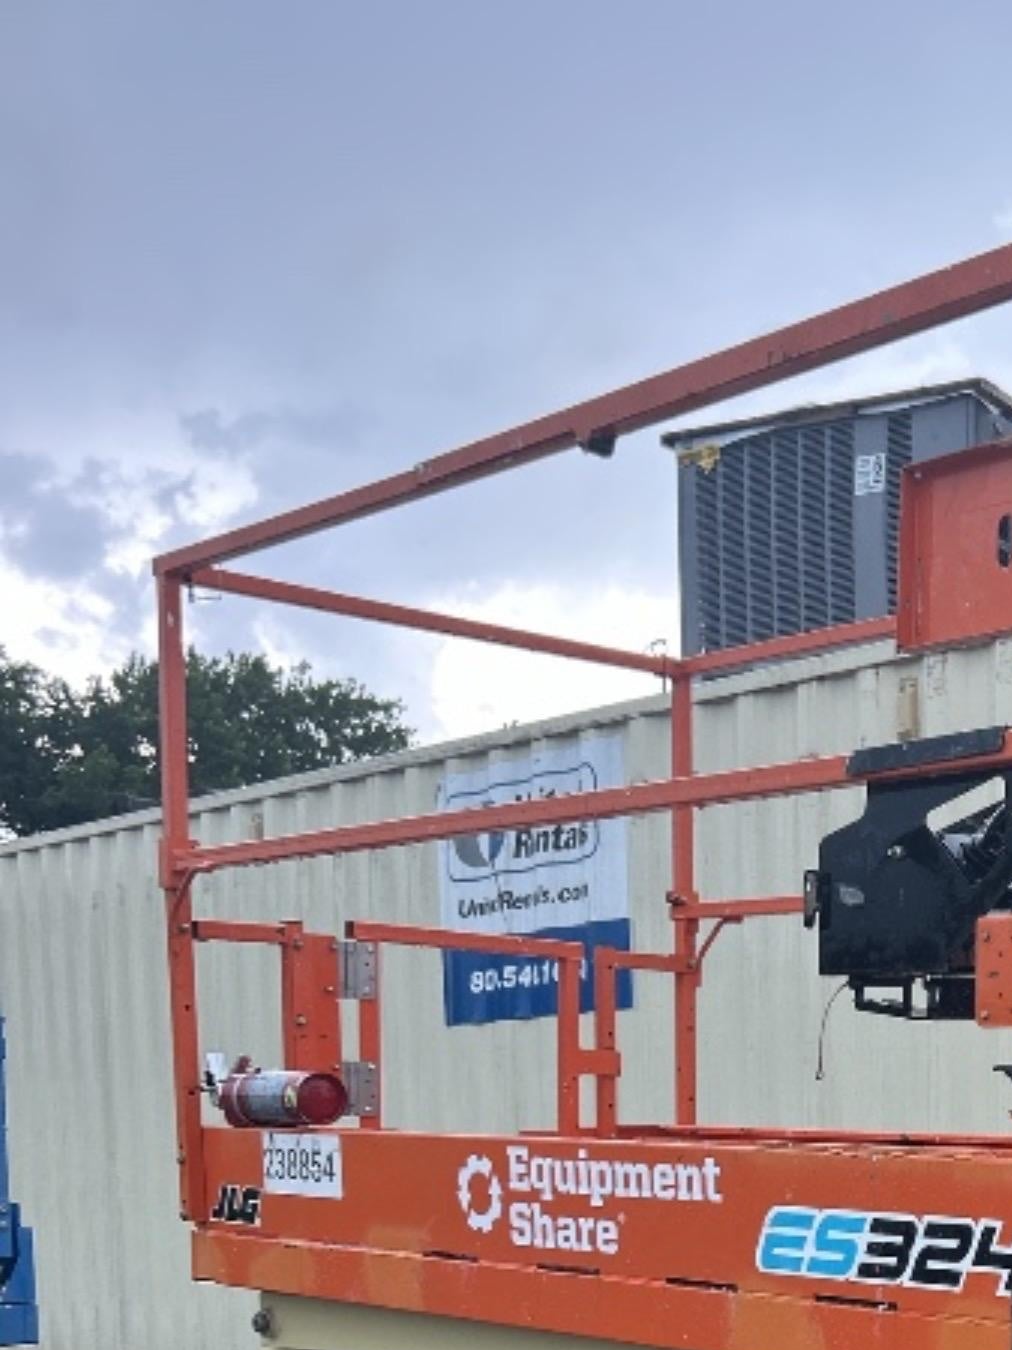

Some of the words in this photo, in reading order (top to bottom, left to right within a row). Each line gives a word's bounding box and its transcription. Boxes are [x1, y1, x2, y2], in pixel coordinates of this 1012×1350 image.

[507, 1145, 723, 1207] Equipment
[209, 1184, 261, 1227] JLG
[509, 1202, 619, 1254] Share
